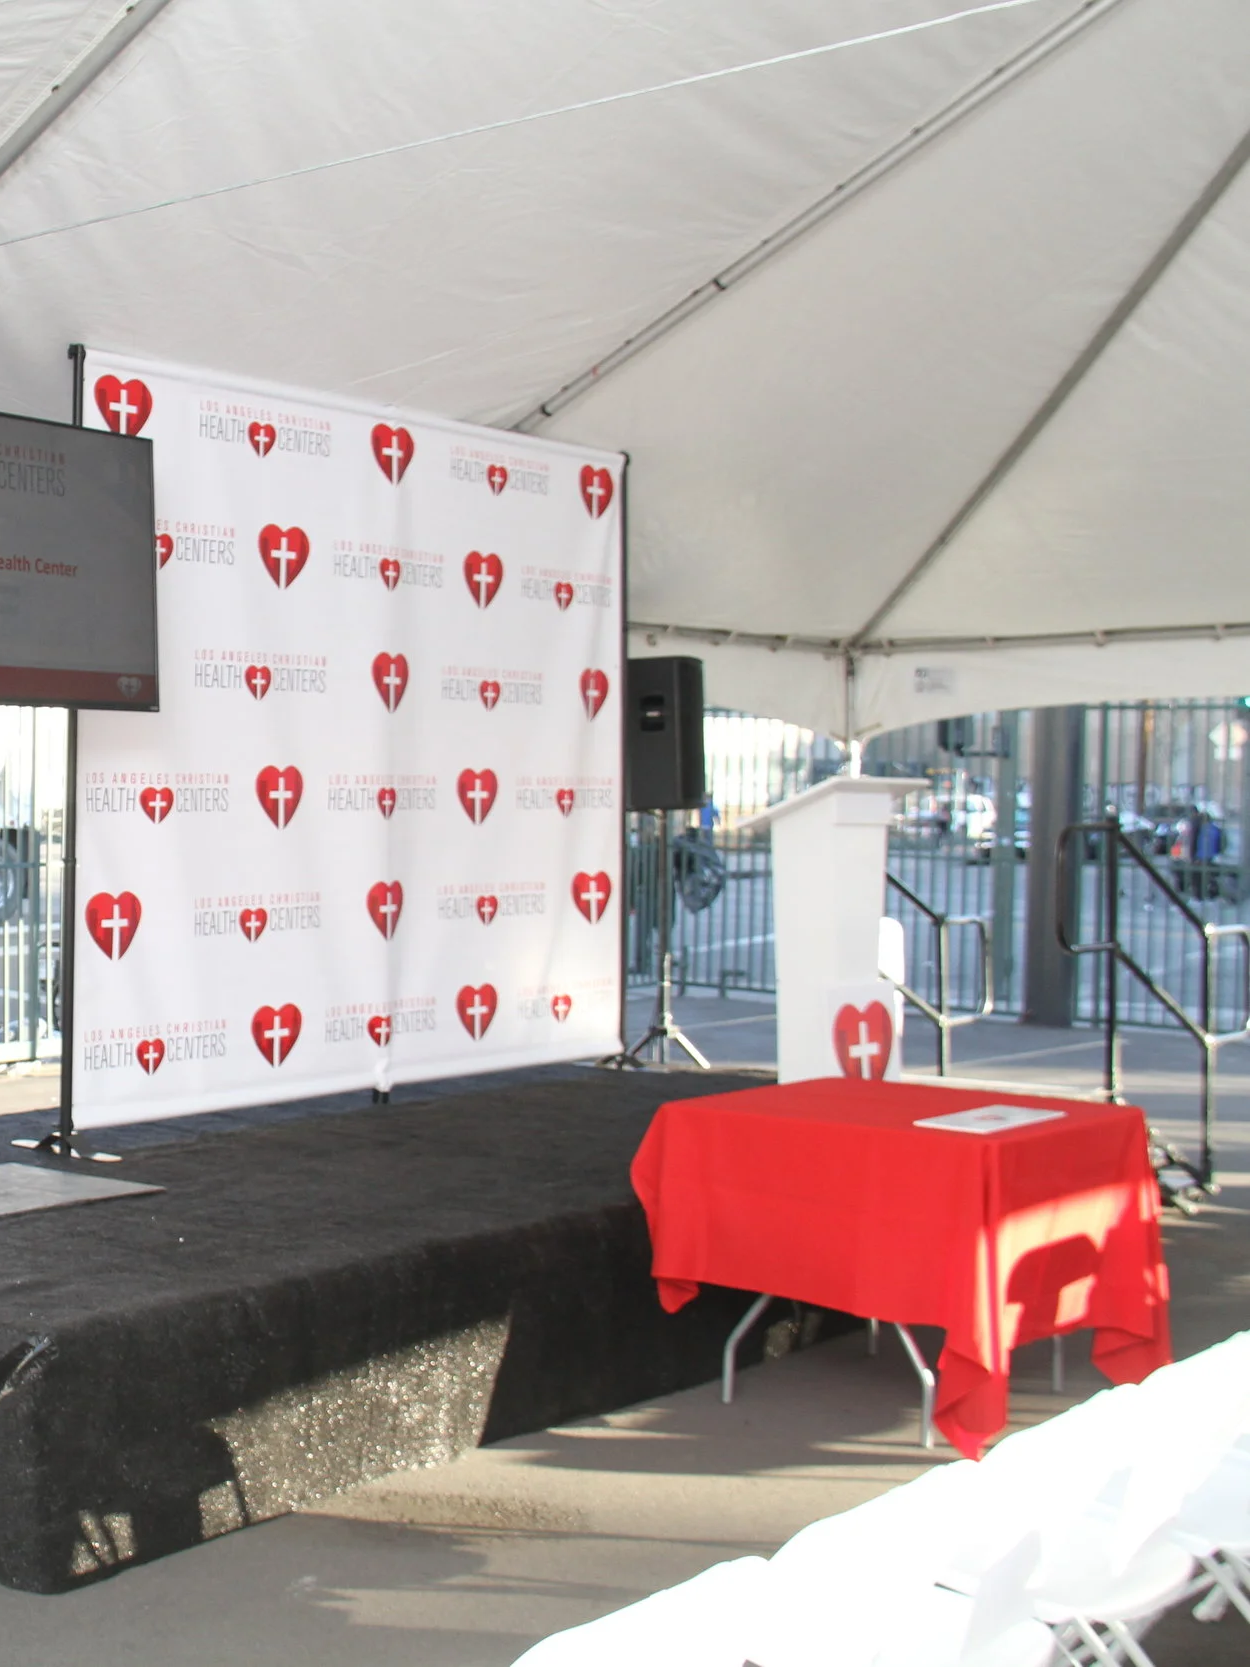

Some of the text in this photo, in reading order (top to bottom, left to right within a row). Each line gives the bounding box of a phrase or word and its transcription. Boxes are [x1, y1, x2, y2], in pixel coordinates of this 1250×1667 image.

[199, 399, 219, 414] LOS
[199, 414, 331, 458] HEALTH CENTERS
[450, 458, 549, 496] HEALTH CENTERS
[175, 520, 234, 539] CHRISTIAN
[175, 535, 235, 566] CENTERS
[35, 558, 79, 578] Center
[333, 554, 378, 580] HEALTH
[195, 649, 214, 661] LOS
[195, 663, 327, 693] HEALTH CENTERS
[441, 678, 542, 705] HEALTH CENTERS
[85, 771, 230, 786] LOS ANGELES CHRISTIAN
[85, 786, 230, 813] HEALTH CENTERS
[327, 787, 375, 811] HEALTH
[194, 897, 212, 909] LOS
[438, 893, 546, 920] HEALTH CENTERS
[194, 904, 322, 937] HEALTH CENTERS
[83, 1019, 226, 1043] LOS ANGELES CHRISTIAN
[325, 1016, 365, 1044] HEALTH
[83, 1032, 226, 1072] HEALTH CENTERS
